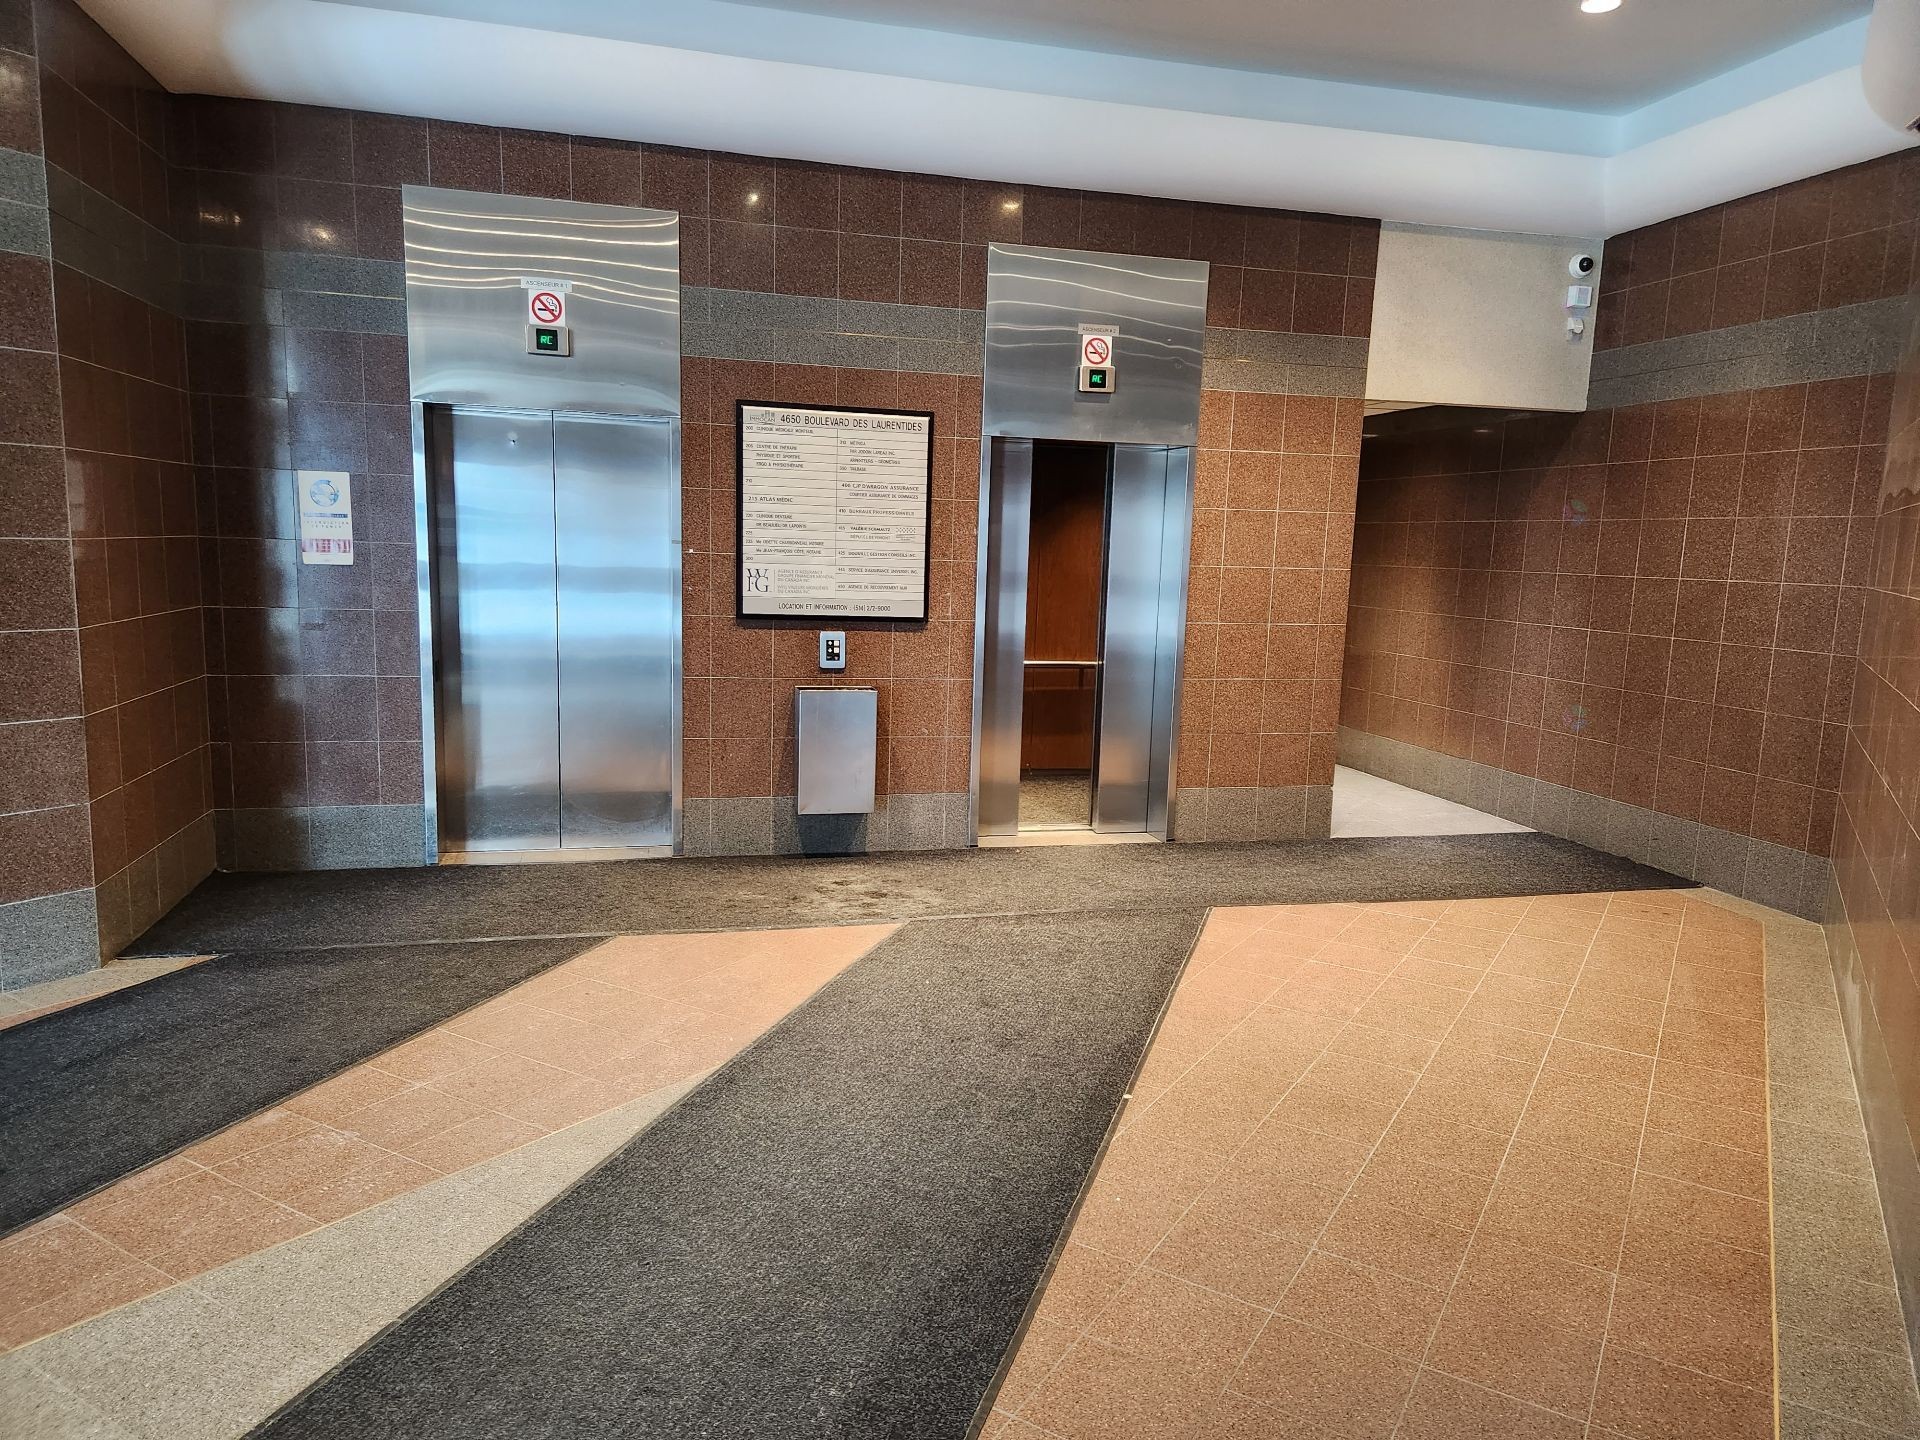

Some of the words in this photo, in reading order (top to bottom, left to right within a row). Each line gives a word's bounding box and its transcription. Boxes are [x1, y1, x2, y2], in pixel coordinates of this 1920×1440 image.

[540, 335, 553, 344] RC
[1092, 374, 1102, 383] RC
[781, 415, 800, 424] 4650
[804, 416, 849, 427] BOULEVARD
[853, 419, 868, 428] DES
[872, 420, 923, 432] LAURENTIDES
